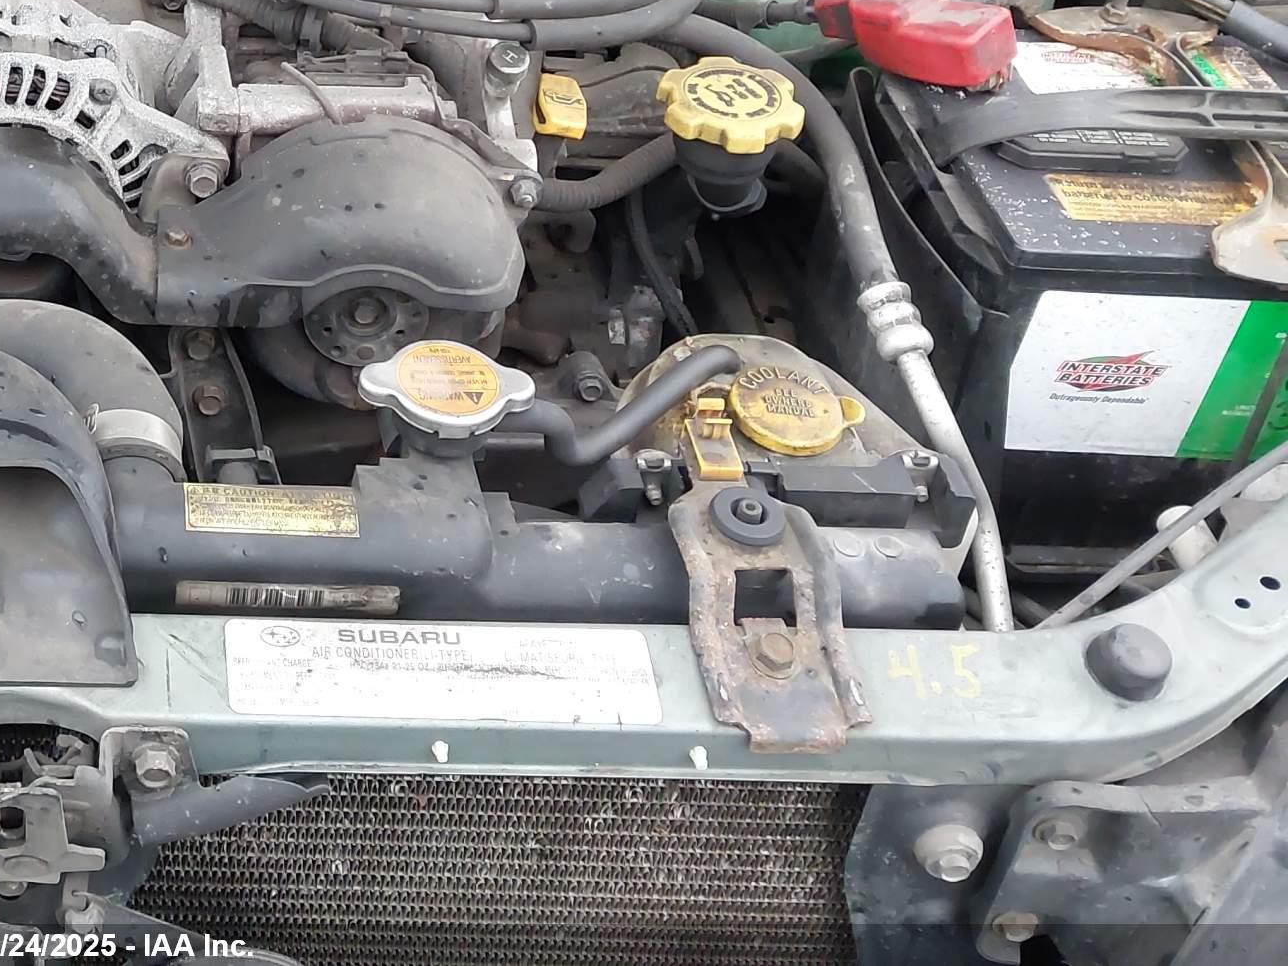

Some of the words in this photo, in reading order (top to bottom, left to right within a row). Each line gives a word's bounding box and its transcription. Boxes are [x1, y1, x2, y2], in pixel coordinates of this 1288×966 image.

[1061, 362, 1163, 377] INTERSTATE
[739, 366, 830, 394] COOLANT
[1059, 373, 1151, 386] BATTERIES
[1049, 392, 1101, 405] Outrageously
[223, 487, 275, 497] CAUTION
[338, 628, 461, 645] SUBARU
[312, 646, 331, 659] AIR
[336, 647, 418, 661] CONDITIONER
[888, 643, 981, 699] 4.5
